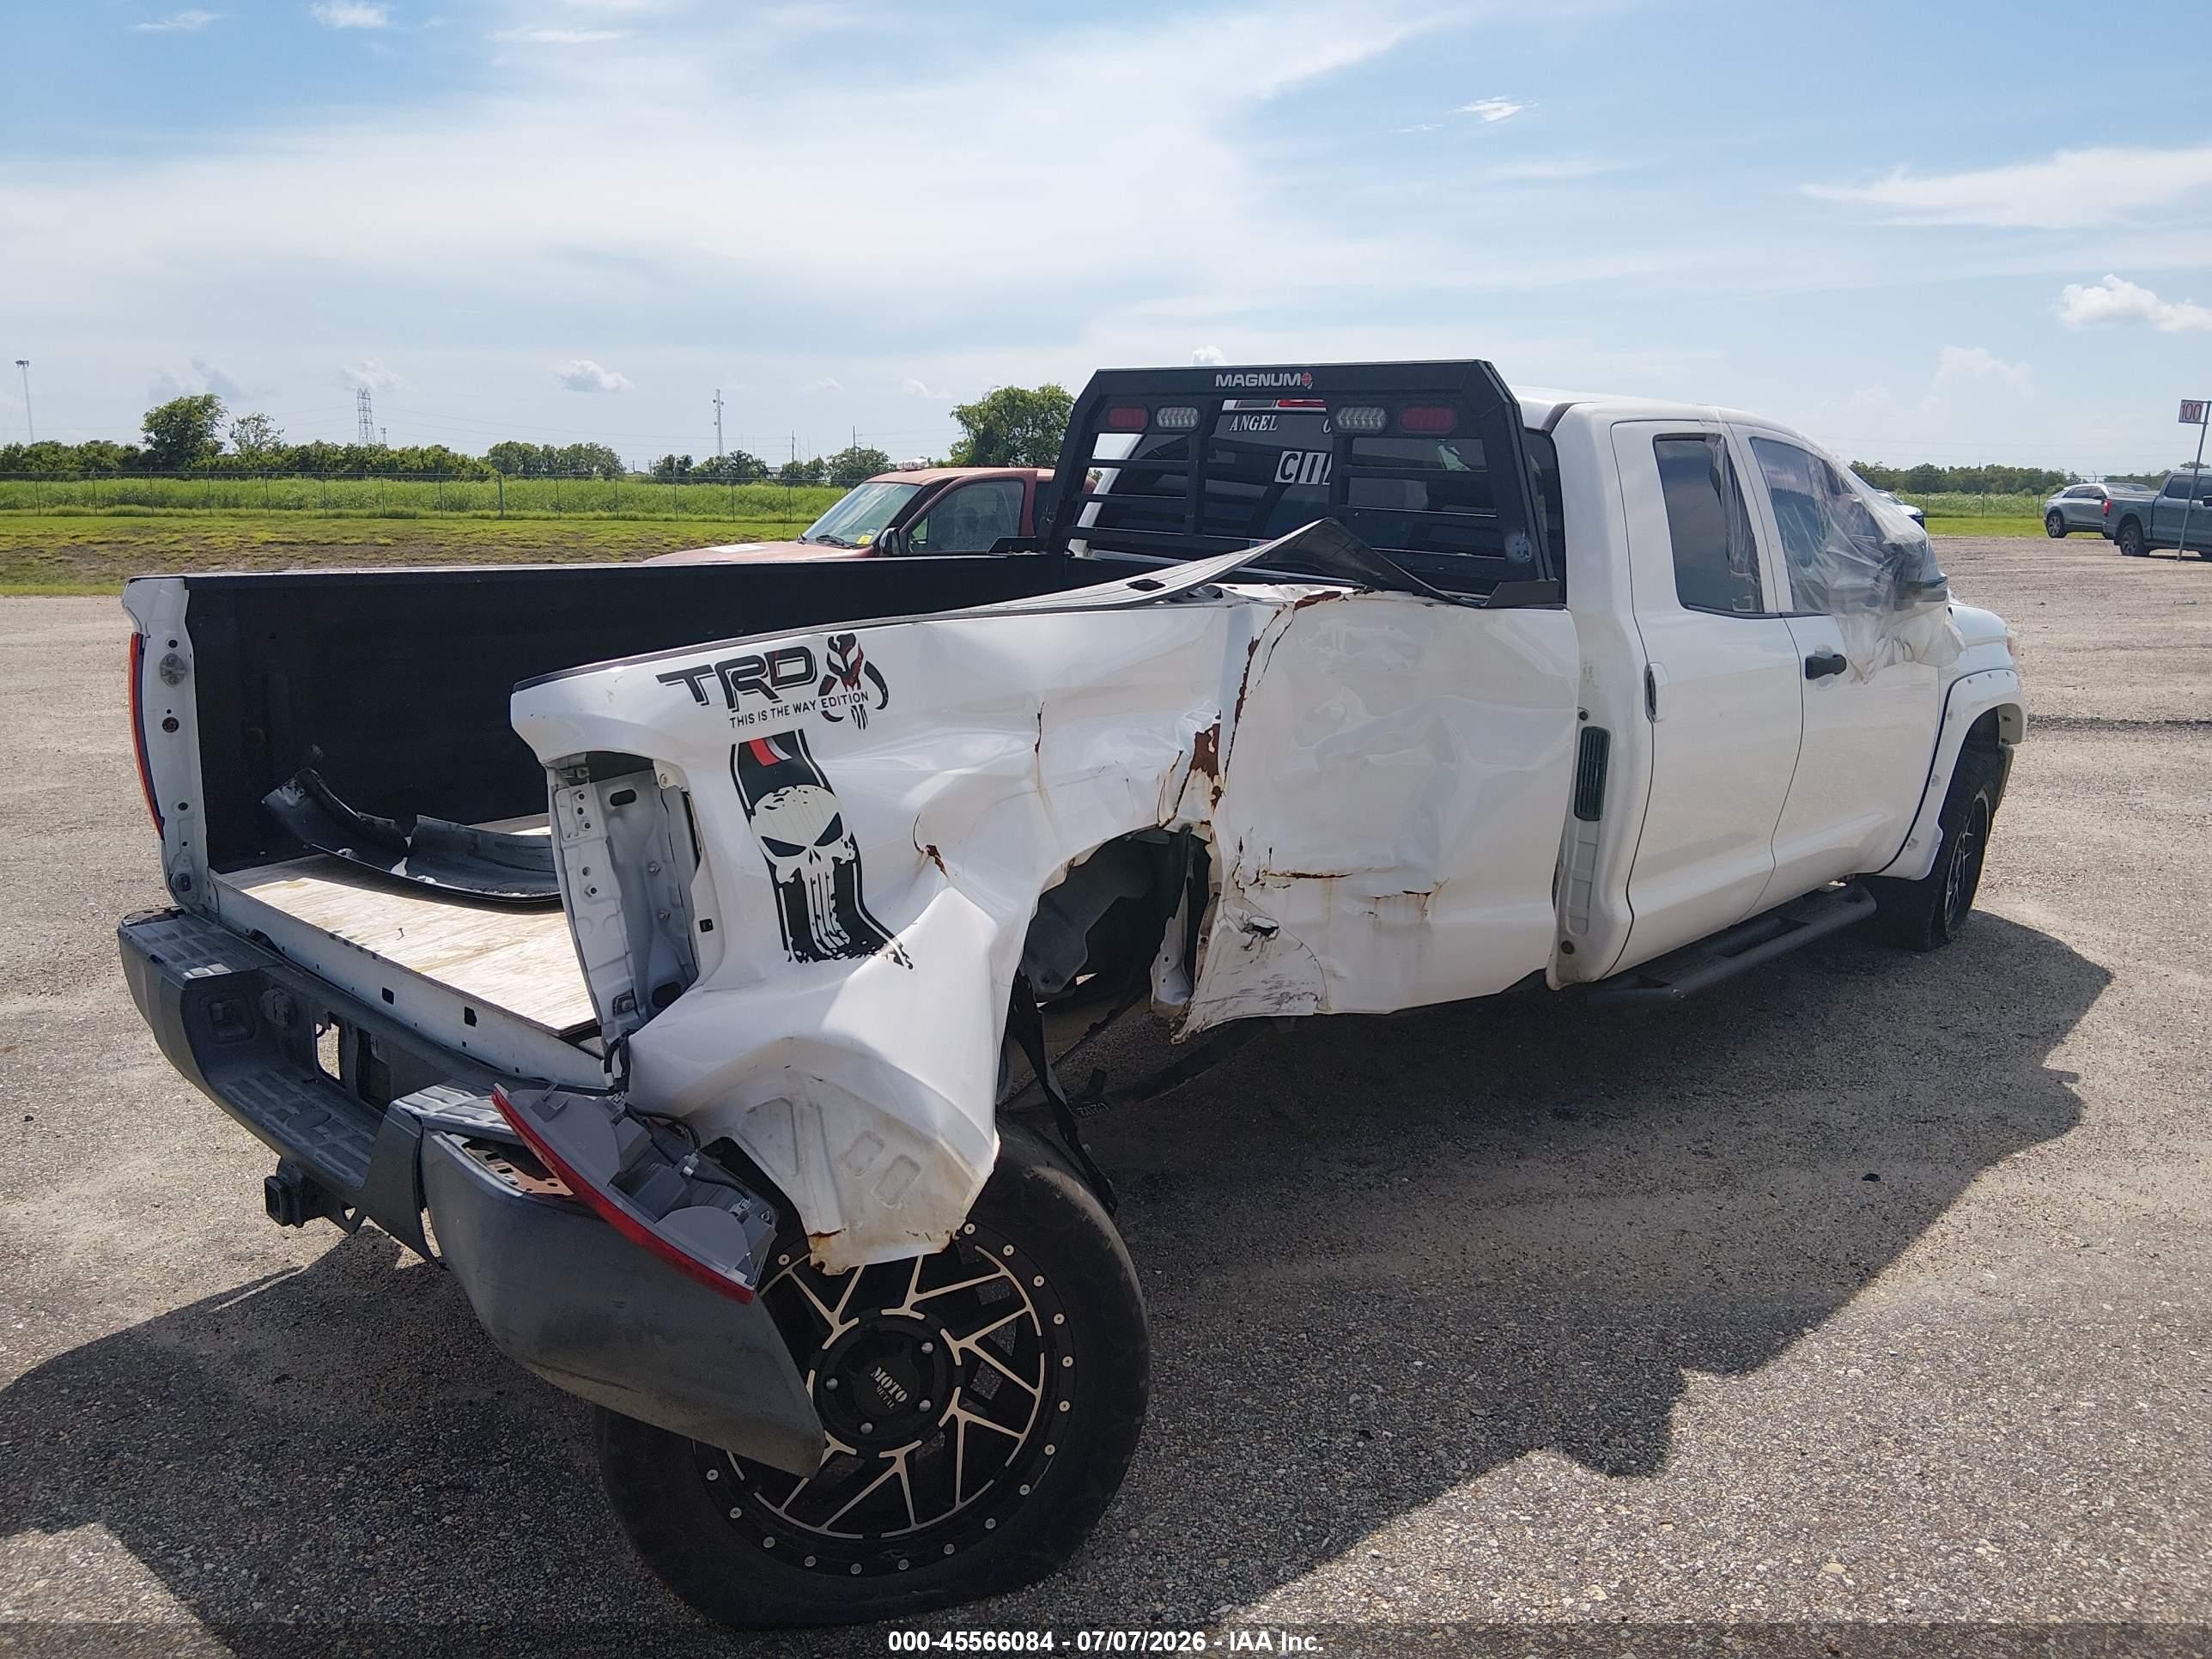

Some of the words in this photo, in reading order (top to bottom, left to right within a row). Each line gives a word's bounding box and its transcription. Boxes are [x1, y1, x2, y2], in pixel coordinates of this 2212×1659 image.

[1215, 373, 1301, 387] MAGNUM
[1229, 415, 1279, 431] ANGEL
[2181, 403, 2202, 421] 100
[655, 646, 817, 713] TRD
[730, 713, 756, 728] THIS
[758, 709, 769, 722] IS
[770, 705, 791, 719] THE
[792, 700, 817, 714] WAY
[820, 691, 870, 708] EDITION
[870, 1366, 908, 1402] MOTO
